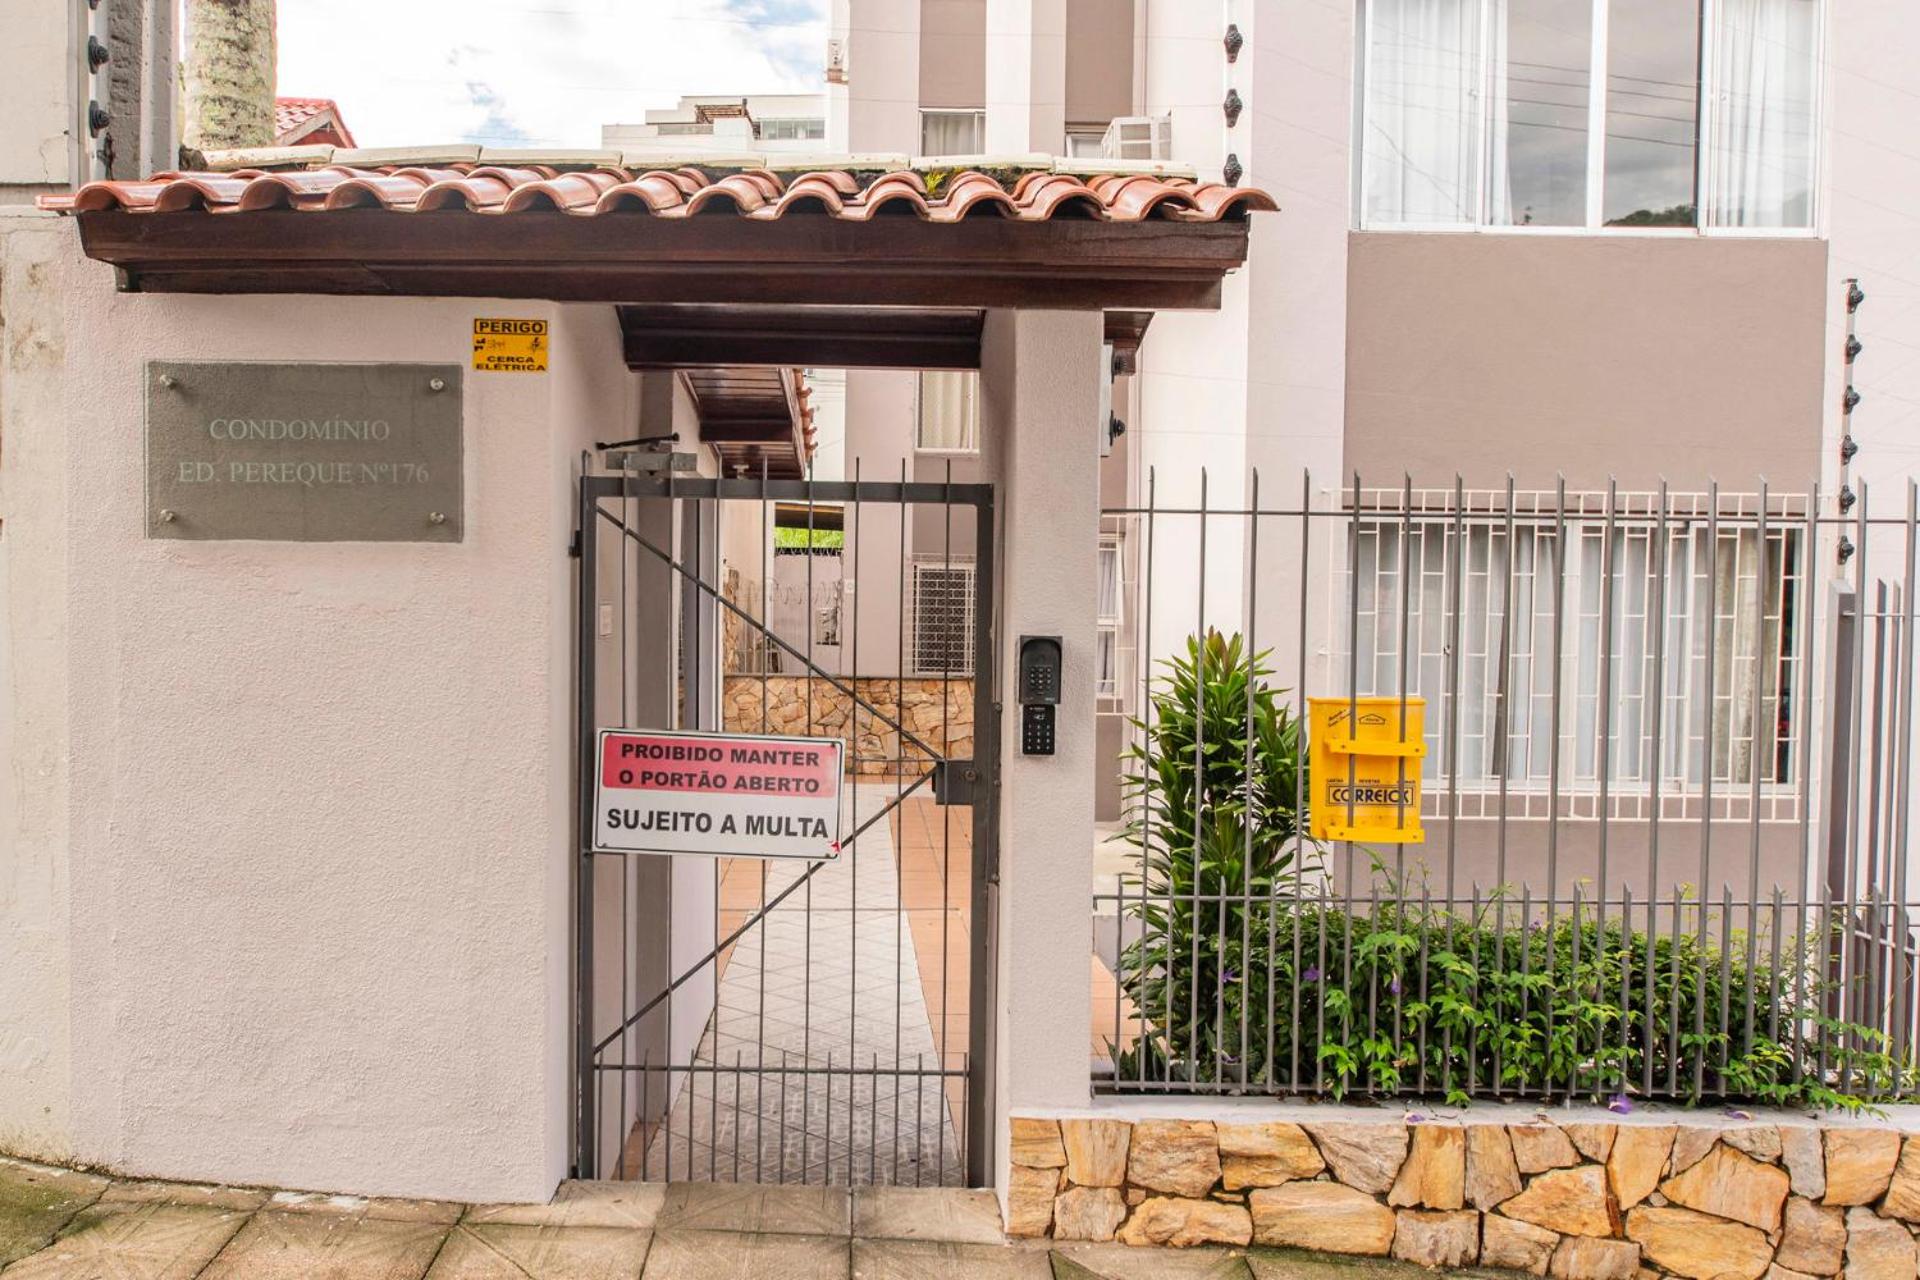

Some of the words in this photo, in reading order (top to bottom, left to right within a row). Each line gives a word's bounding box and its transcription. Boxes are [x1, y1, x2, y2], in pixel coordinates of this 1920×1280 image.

[479, 322, 543, 333] PERIGO
[487, 355, 534, 363] CERCA
[209, 414, 390, 441] CONDOMÍNIO
[178, 462, 221, 483] ED.
[230, 462, 354, 487] PEREQUE
[621, 743, 724, 762] PROIBIDO
[730, 749, 820, 766] MANTER
[619, 770, 634, 784] O
[640, 770, 727, 789] PORTÃO
[733, 775, 820, 793] ABERTO
[607, 808, 713, 833] SUJEITO
[720, 814, 737, 834] A
[745, 815, 829, 838] MULTA
